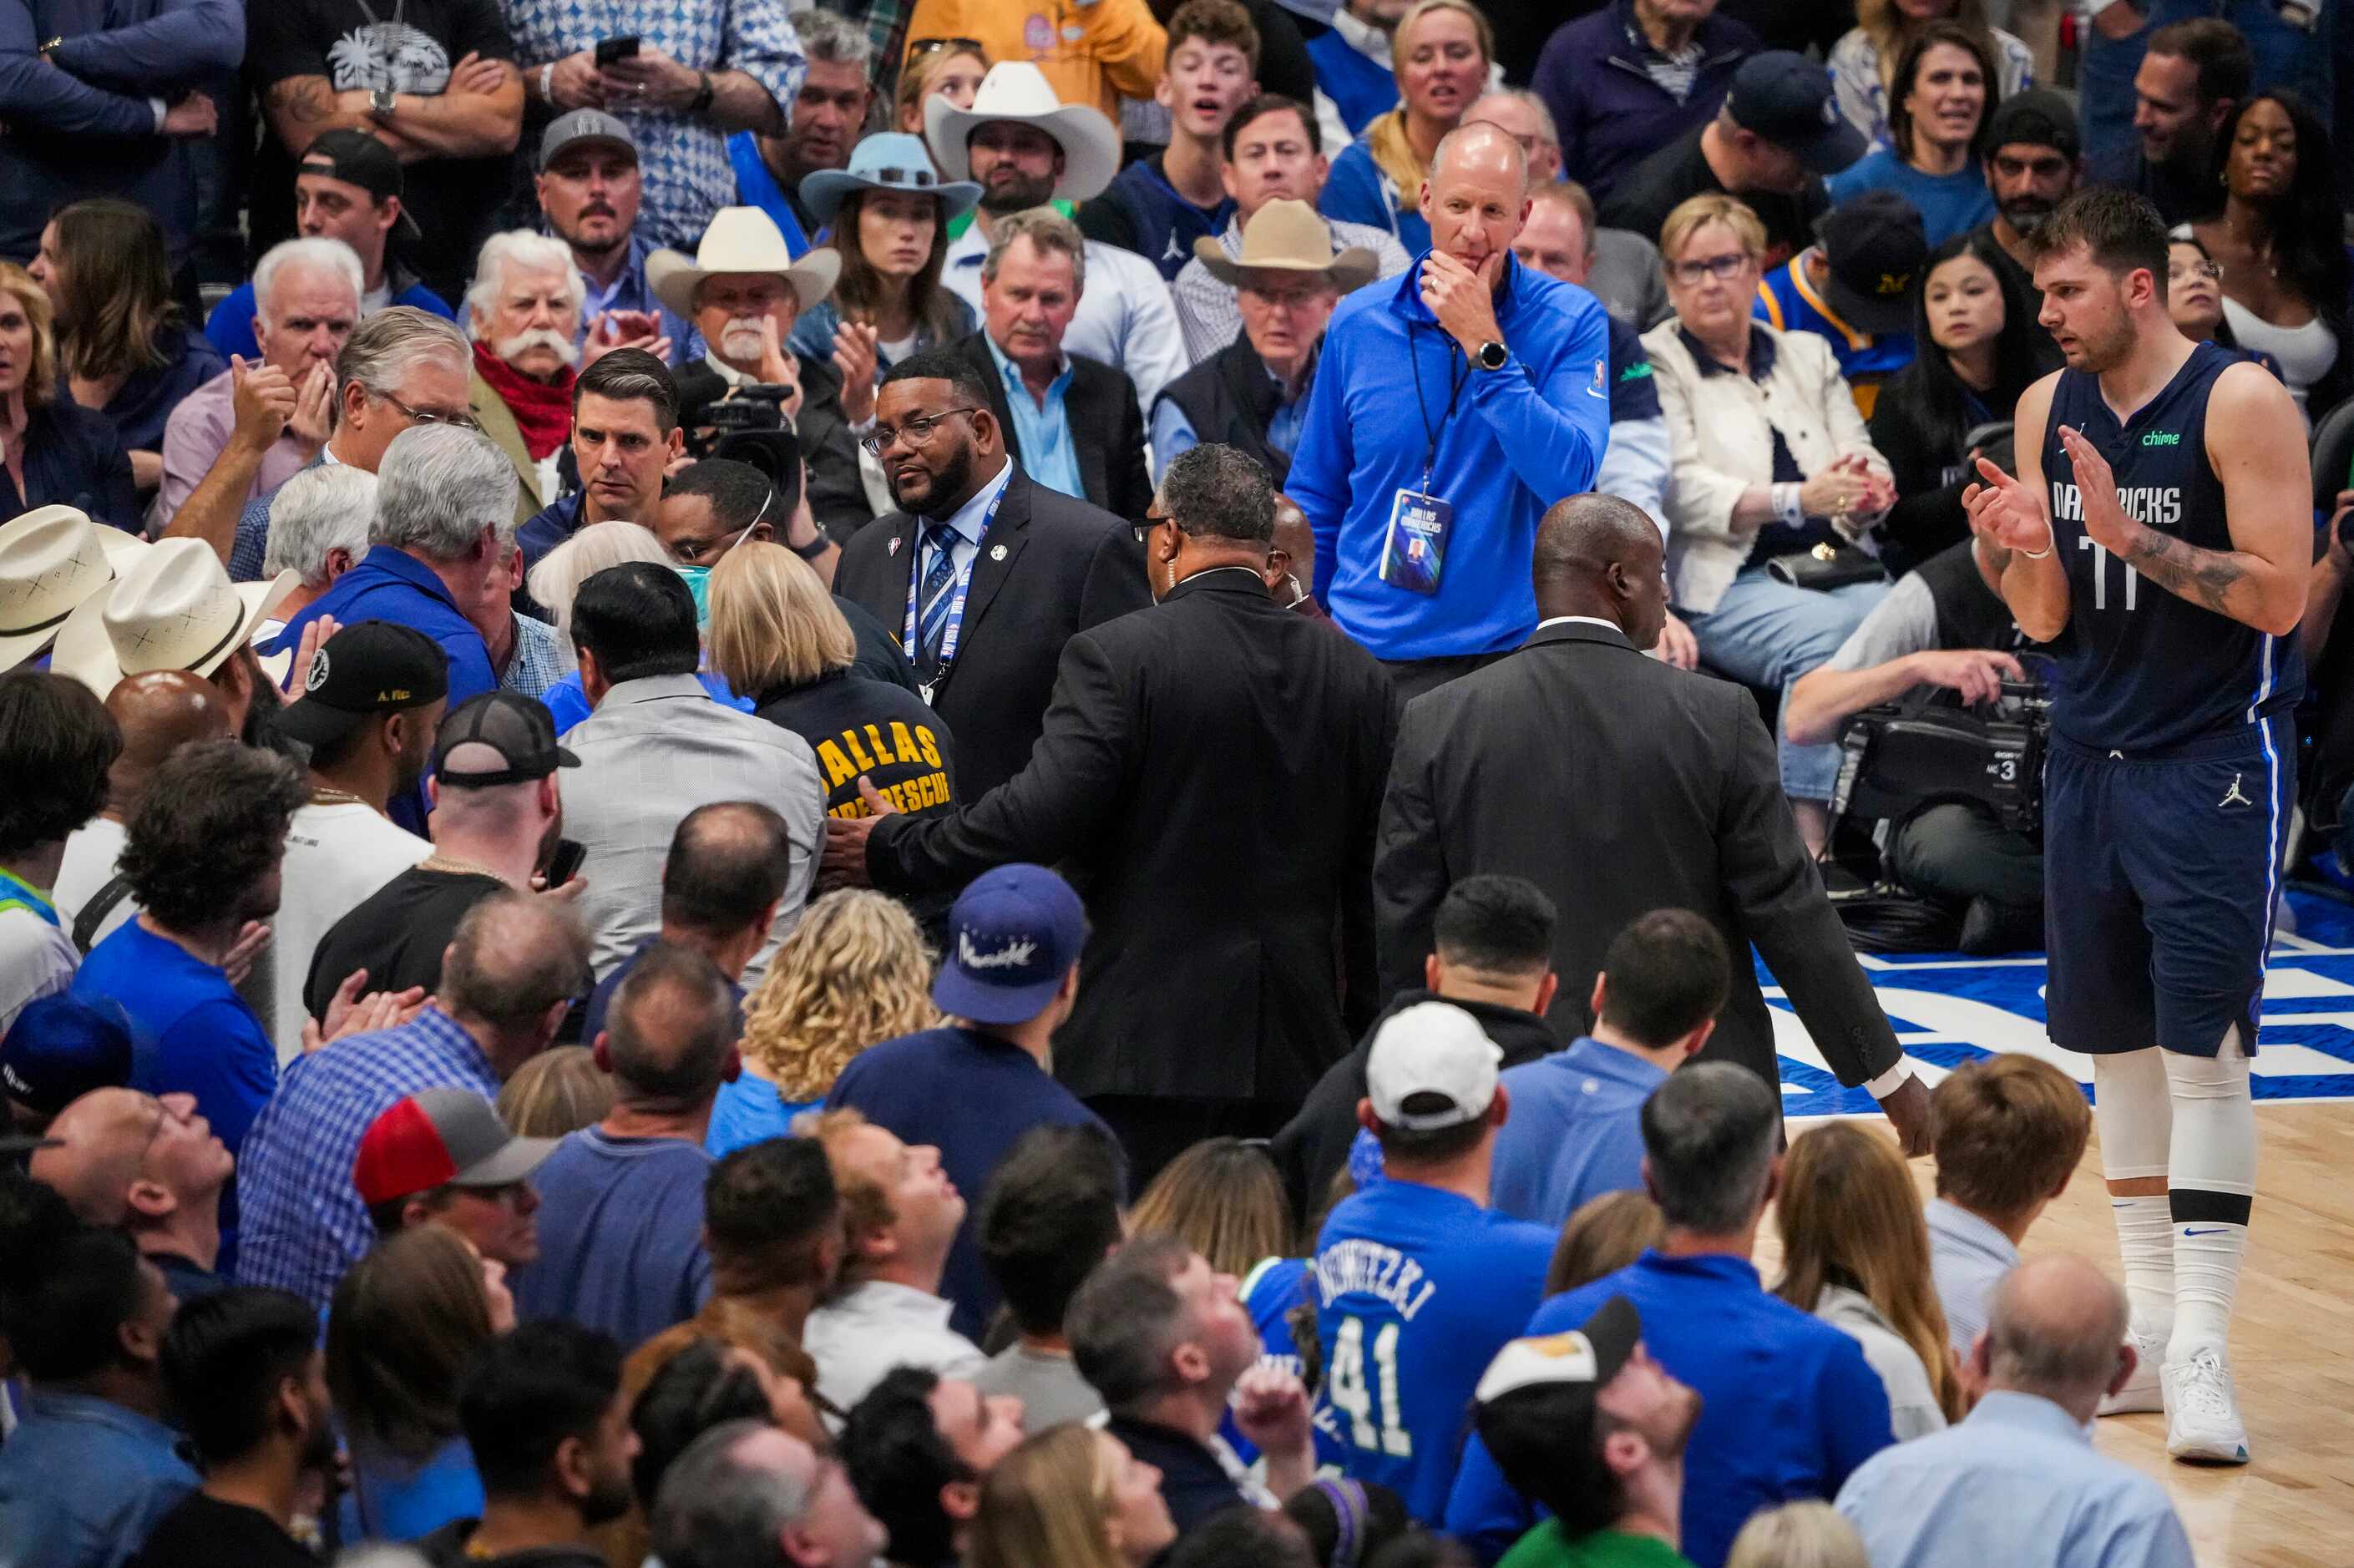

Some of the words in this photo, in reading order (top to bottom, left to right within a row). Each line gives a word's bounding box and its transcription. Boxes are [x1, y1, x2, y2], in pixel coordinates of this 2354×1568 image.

[2142, 430, 2180, 447] chime
[815, 721, 943, 797] ALLAS
[2000, 760, 2017, 781] 3
[1329, 1316, 1413, 1458] 41
